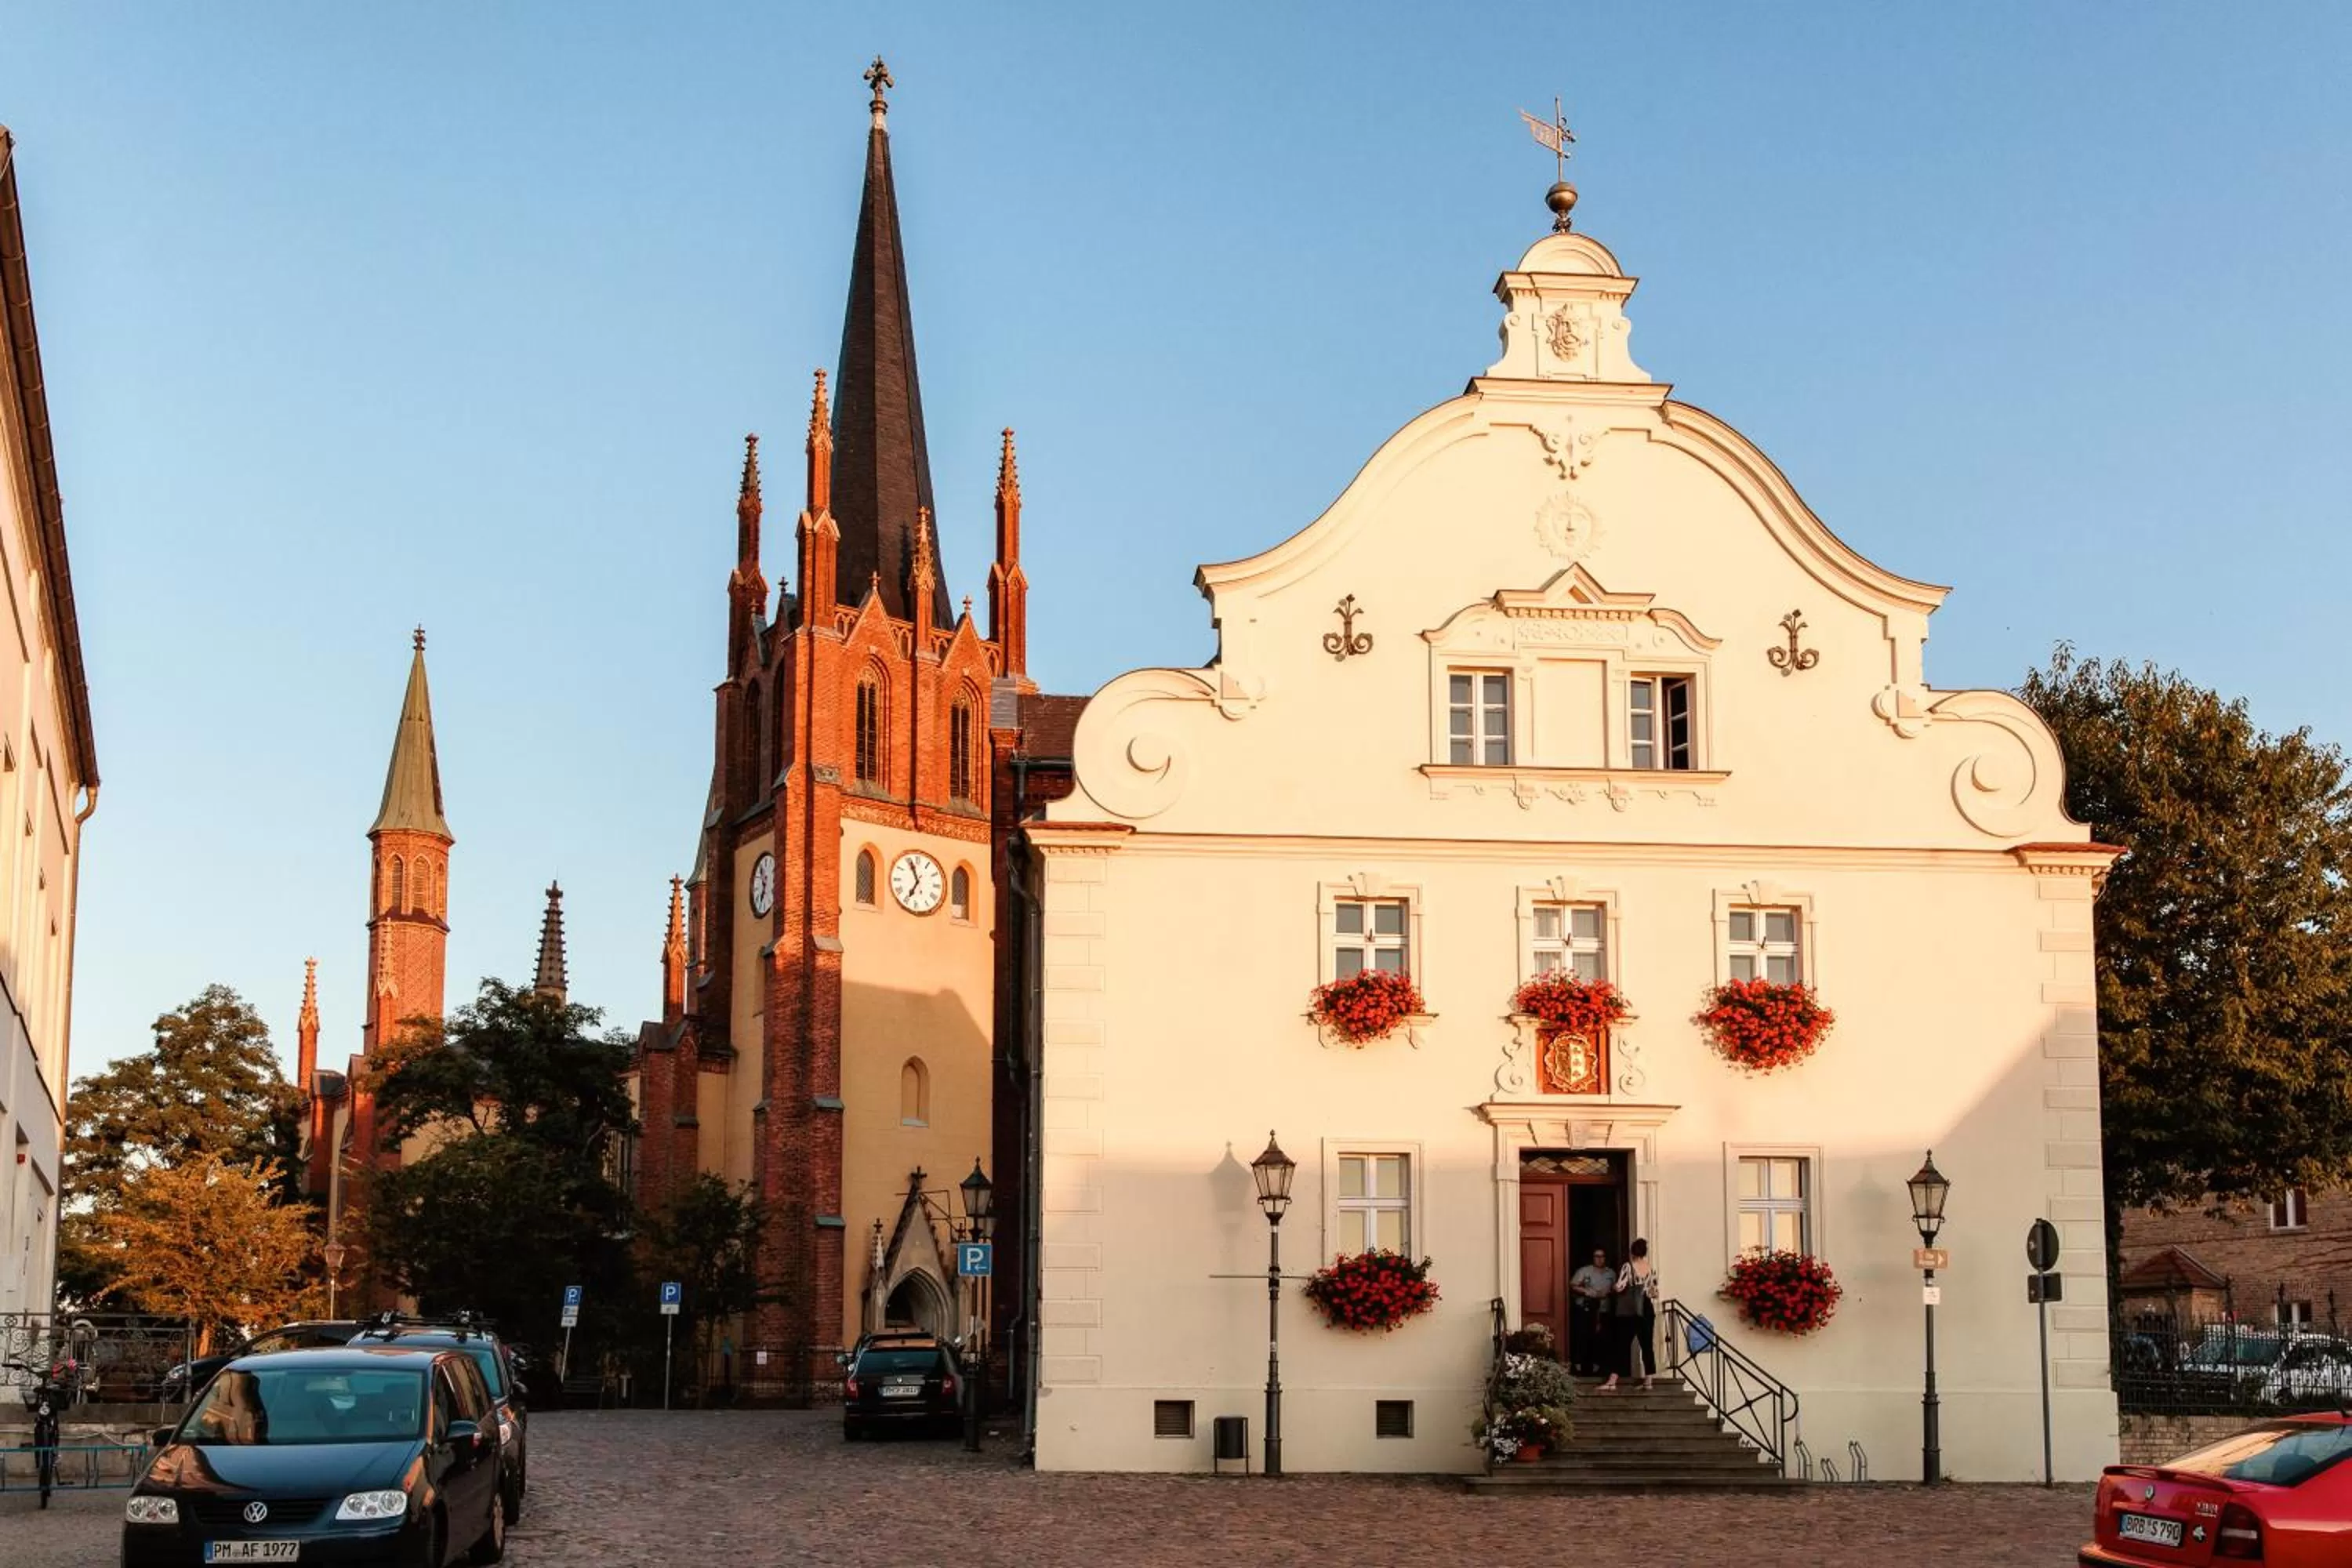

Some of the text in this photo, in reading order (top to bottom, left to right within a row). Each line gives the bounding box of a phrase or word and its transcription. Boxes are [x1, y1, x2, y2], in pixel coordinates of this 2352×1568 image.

[967, 1247, 984, 1271] P
[568, 1288, 578, 1302] P
[666, 1286, 676, 1301] P
[2160, 1522, 2180, 1541] 790
[213, 1542, 298, 1558] PM AF 1977
